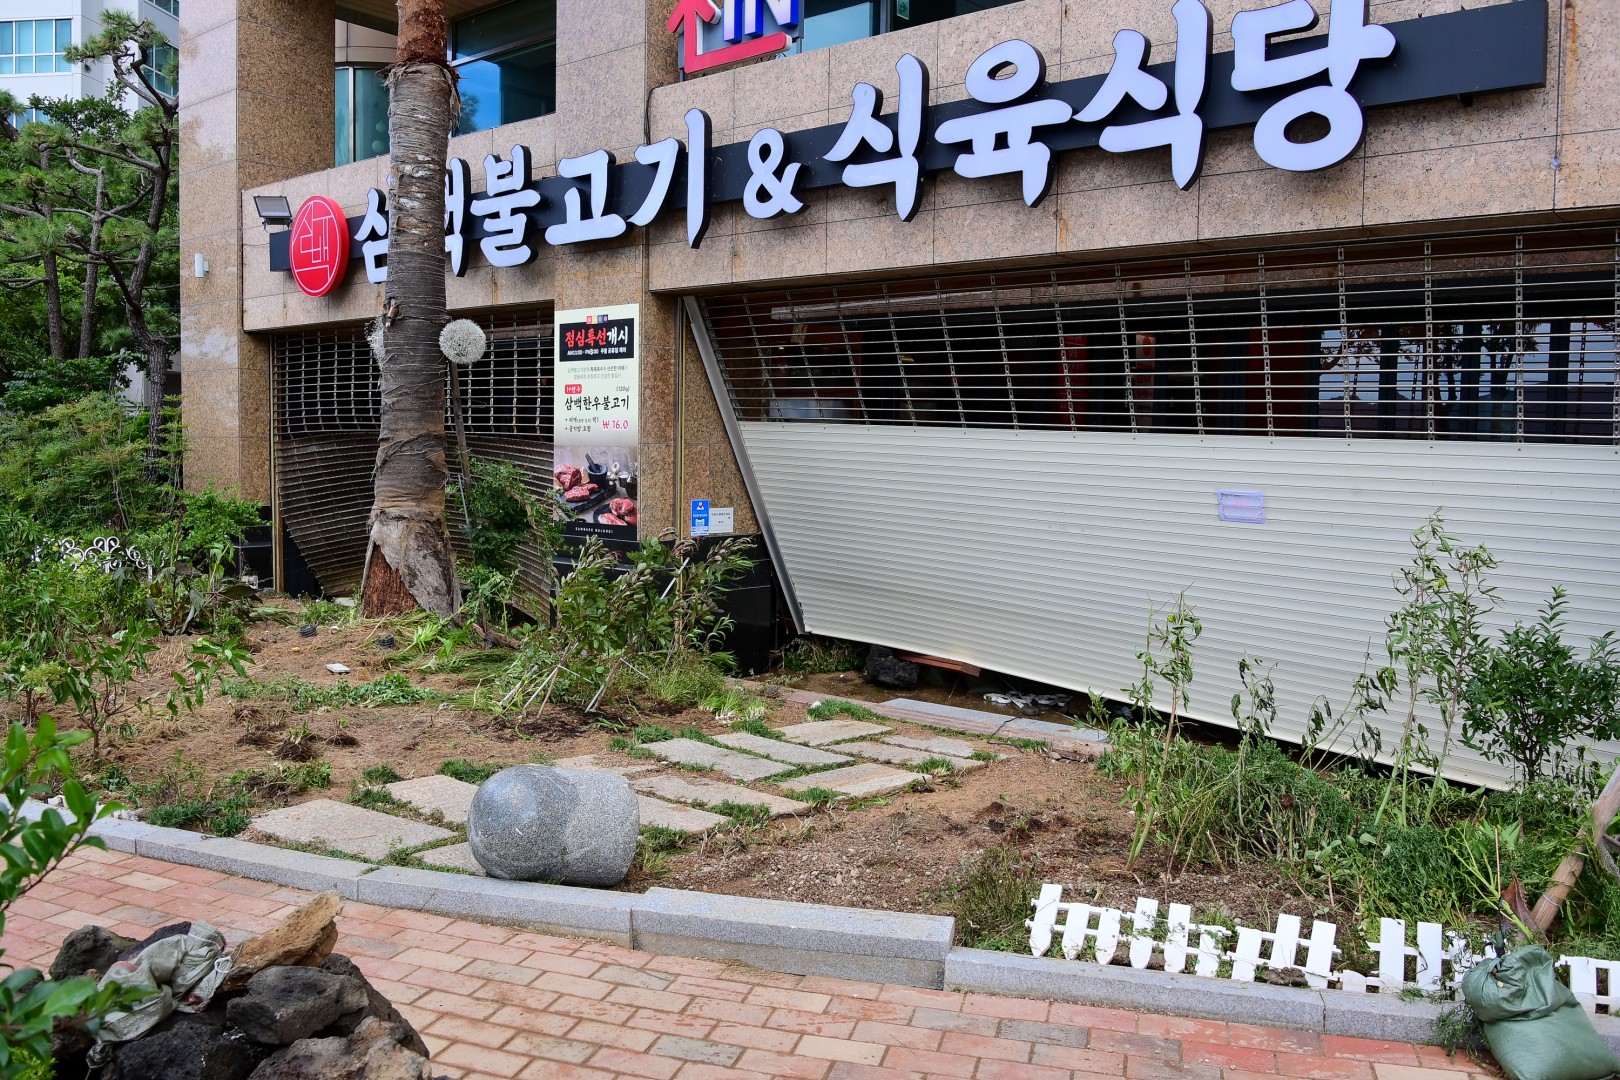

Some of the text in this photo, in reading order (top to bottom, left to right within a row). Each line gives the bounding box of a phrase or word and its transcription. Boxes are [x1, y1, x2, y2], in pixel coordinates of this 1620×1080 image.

[743, 127, 804, 219] &
[823, 0, 1397, 222] 식육식당
[565, 325, 629, 348] 점심특선개시
[564, 394, 630, 411] 삼백한우불고기
